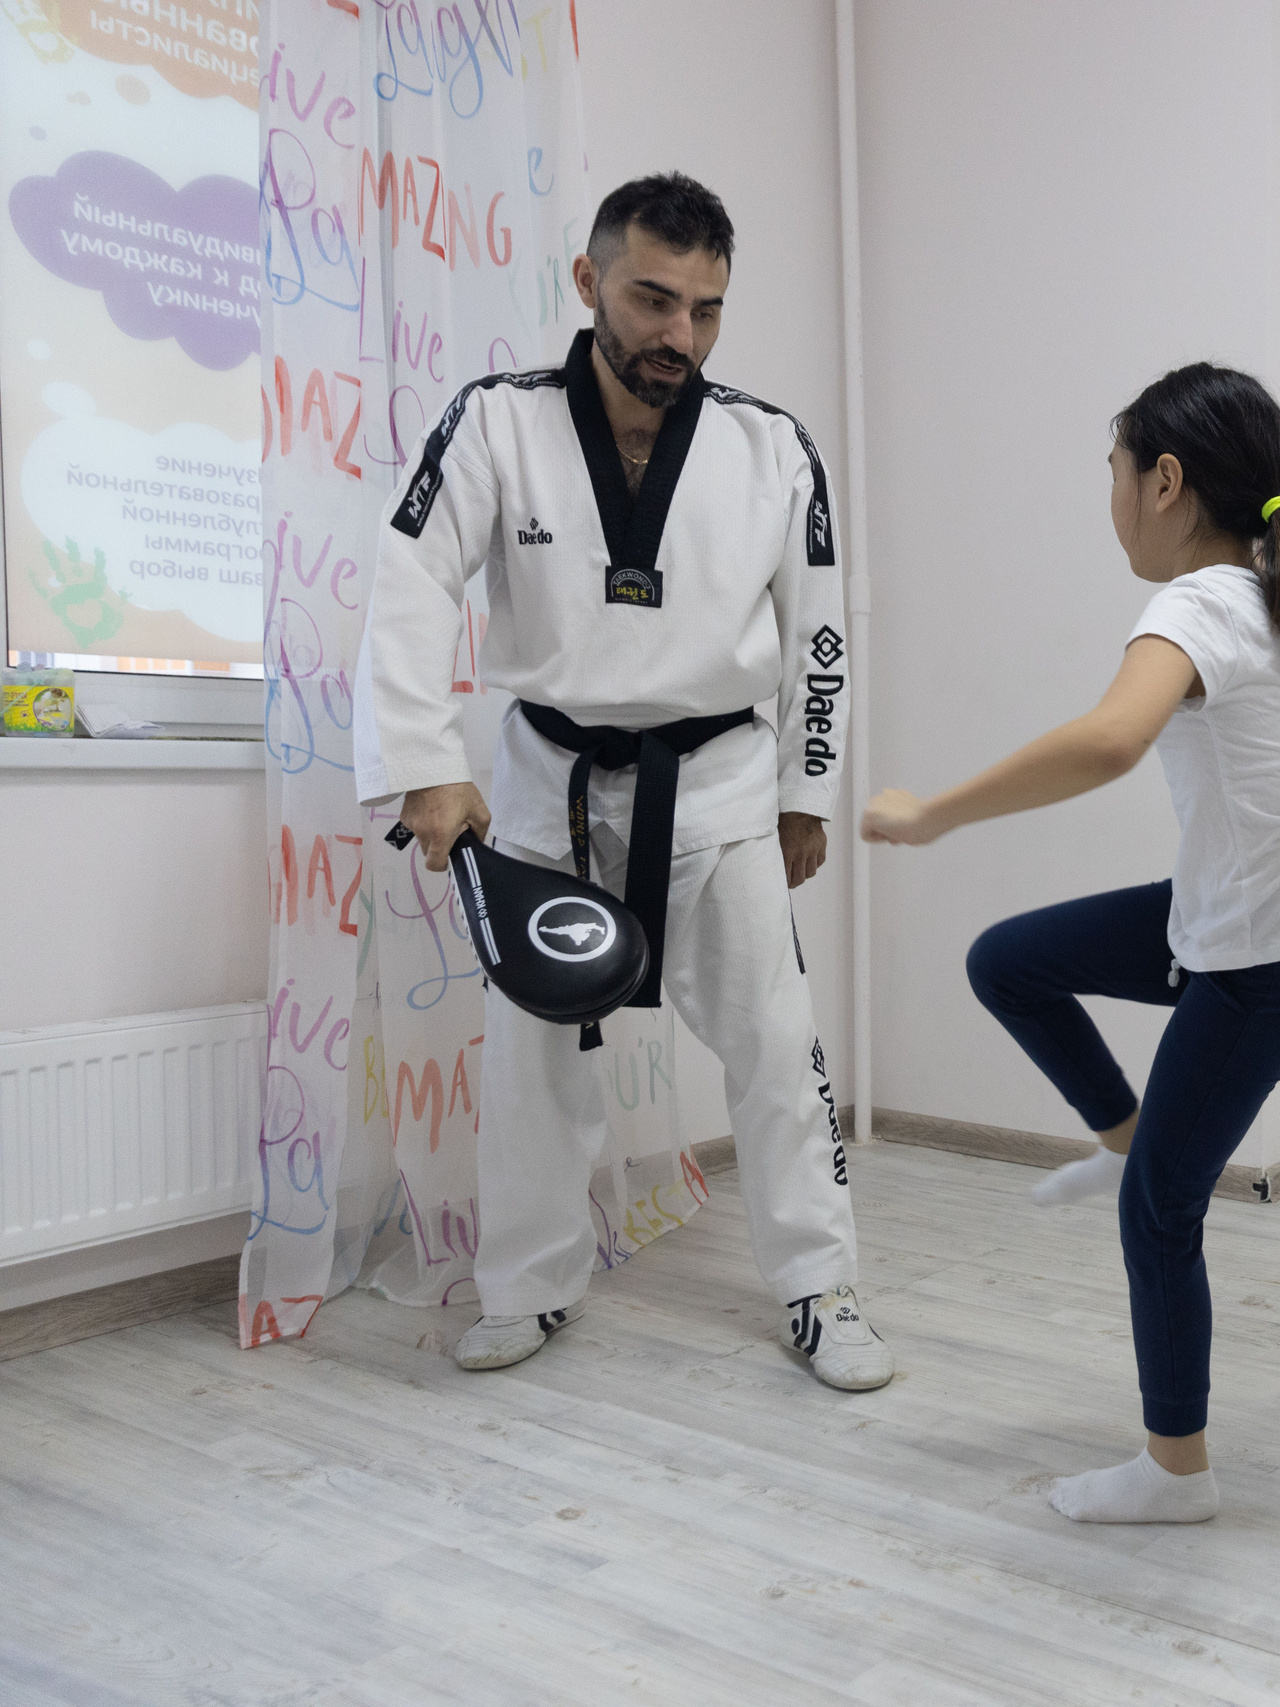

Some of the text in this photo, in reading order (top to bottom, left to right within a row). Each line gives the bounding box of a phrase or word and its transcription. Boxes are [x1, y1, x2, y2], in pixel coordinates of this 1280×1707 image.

[269, 42, 356, 149] ive
[408, 469, 432, 519] WTF
[517, 528, 553, 545] Daedo
[814, 500, 828, 548] WTF
[613, 571, 651, 590] TAEKWONDO
[804, 673, 844, 777] Daedo
